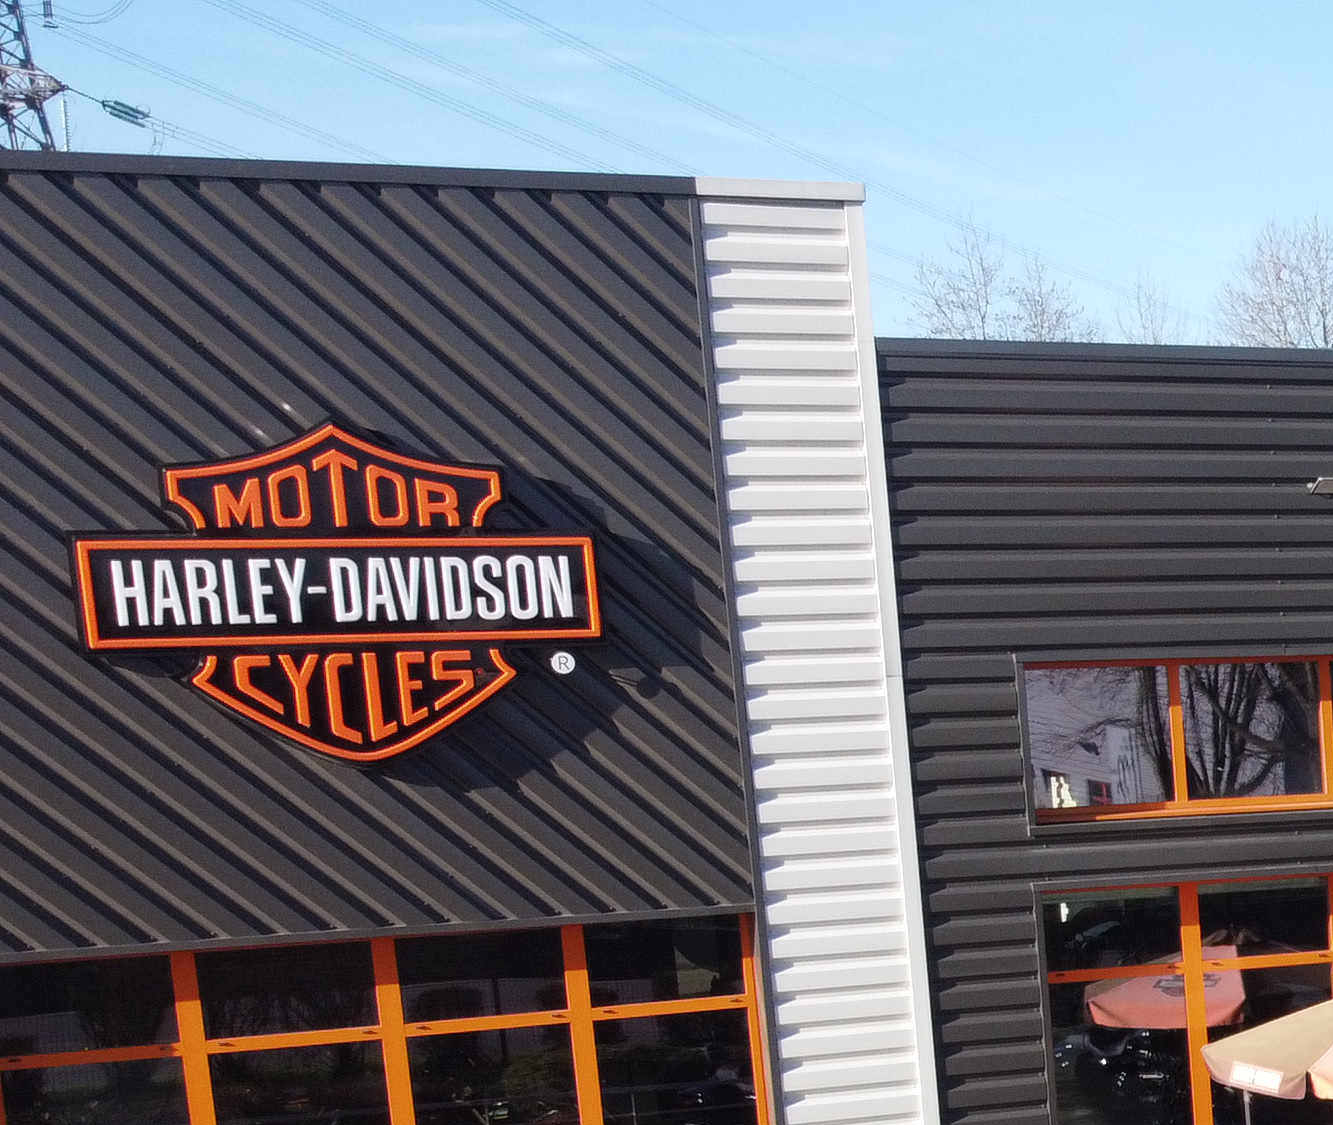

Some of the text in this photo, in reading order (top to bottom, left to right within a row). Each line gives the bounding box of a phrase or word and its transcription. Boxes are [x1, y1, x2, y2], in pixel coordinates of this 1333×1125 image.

[213, 449, 462, 529] MOTOR
[109, 554, 574, 627] HARLEY-DAVIDSON
[234, 648, 476, 744] CYCLES
